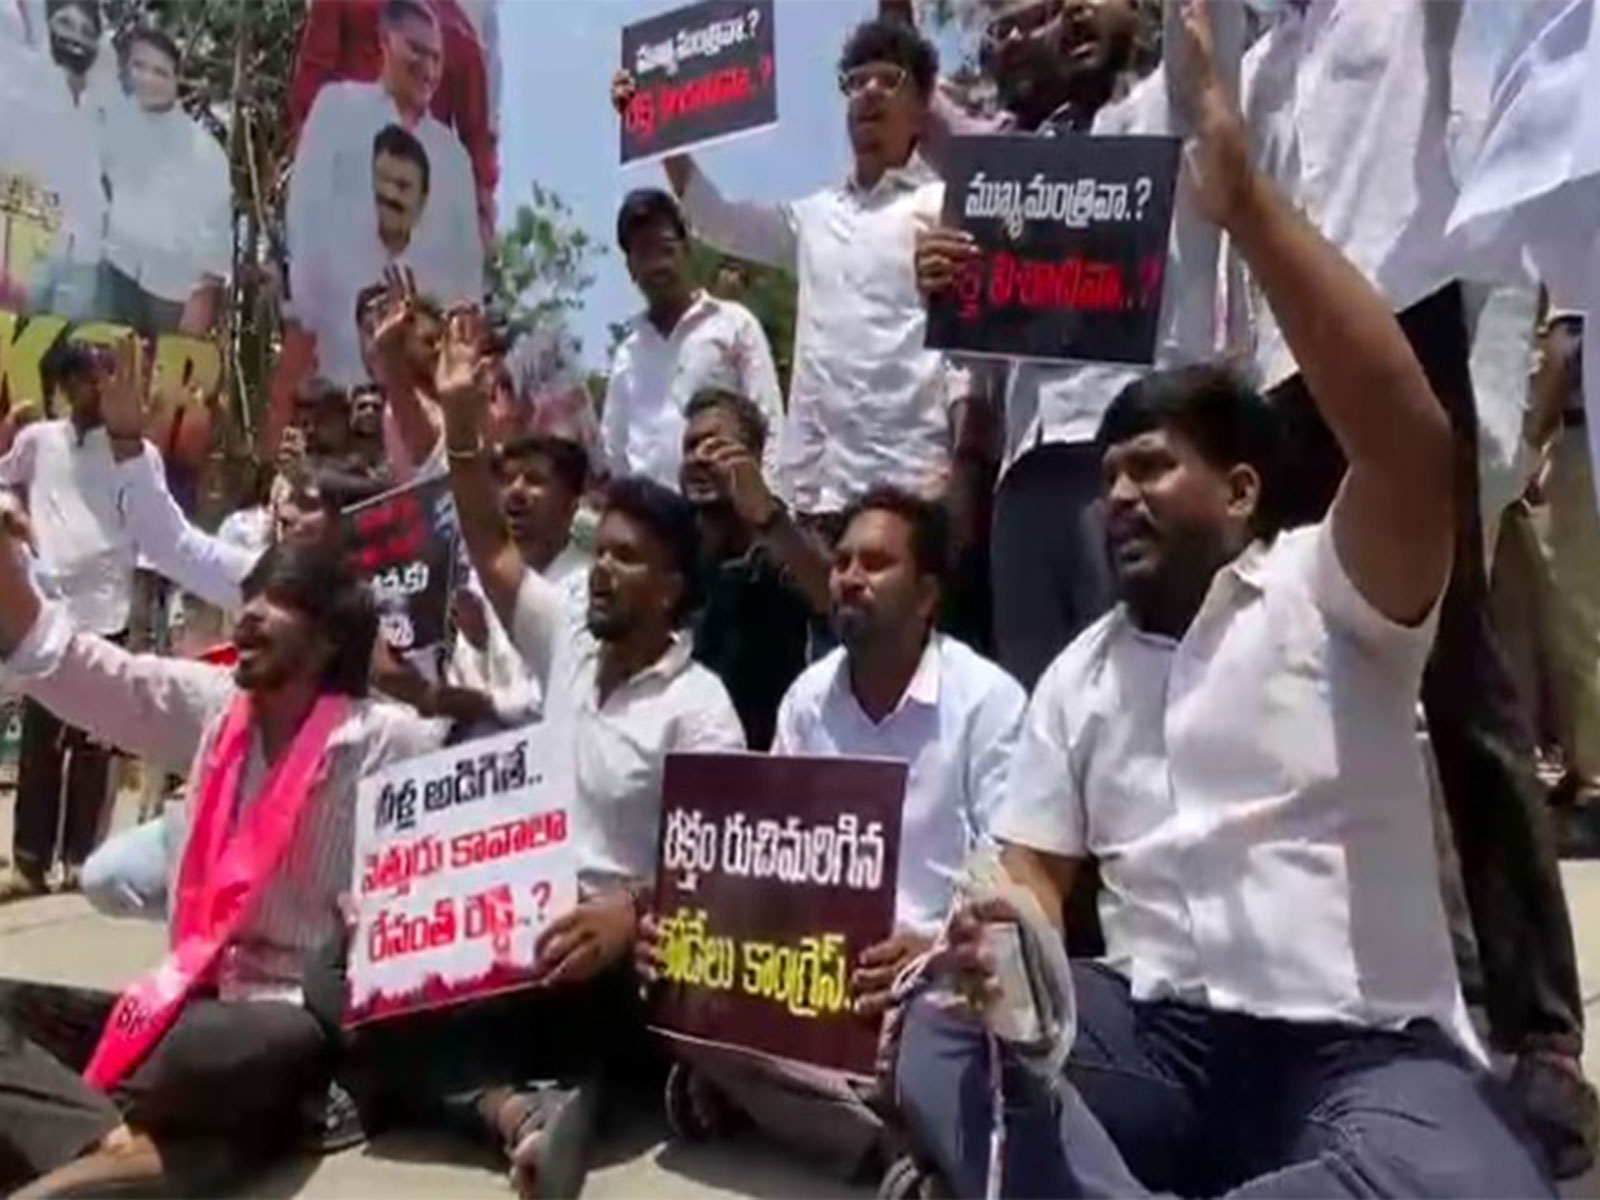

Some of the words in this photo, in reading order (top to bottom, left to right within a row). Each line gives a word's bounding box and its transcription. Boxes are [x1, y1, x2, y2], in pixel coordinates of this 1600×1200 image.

[450, 808, 568, 868] కావాలా
[664, 807, 717, 891] రక్తం
[655, 907, 735, 990] తోడేలు
